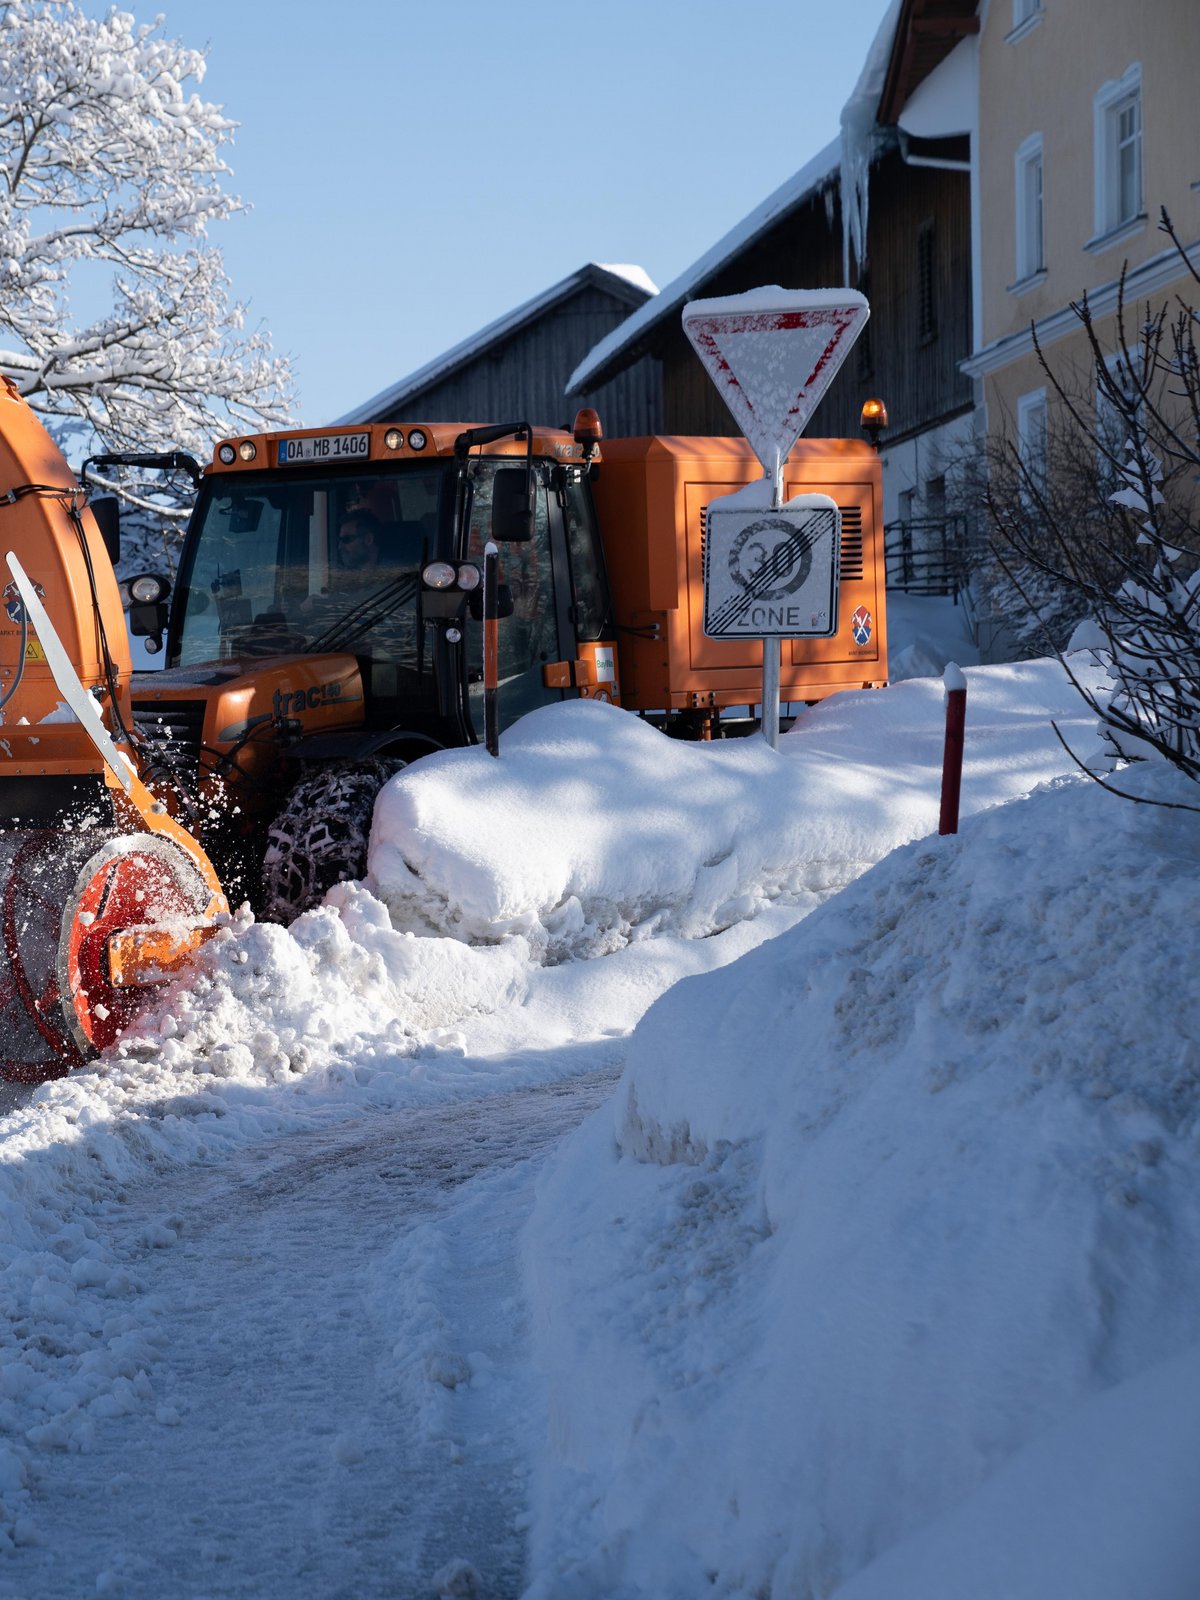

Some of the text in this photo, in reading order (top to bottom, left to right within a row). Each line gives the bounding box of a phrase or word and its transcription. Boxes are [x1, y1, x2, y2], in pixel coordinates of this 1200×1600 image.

[288, 436, 367, 458] OA MB 1406
[747, 541, 793, 579] 30
[737, 606, 800, 626] ZONE
[272, 687, 320, 718] trac
